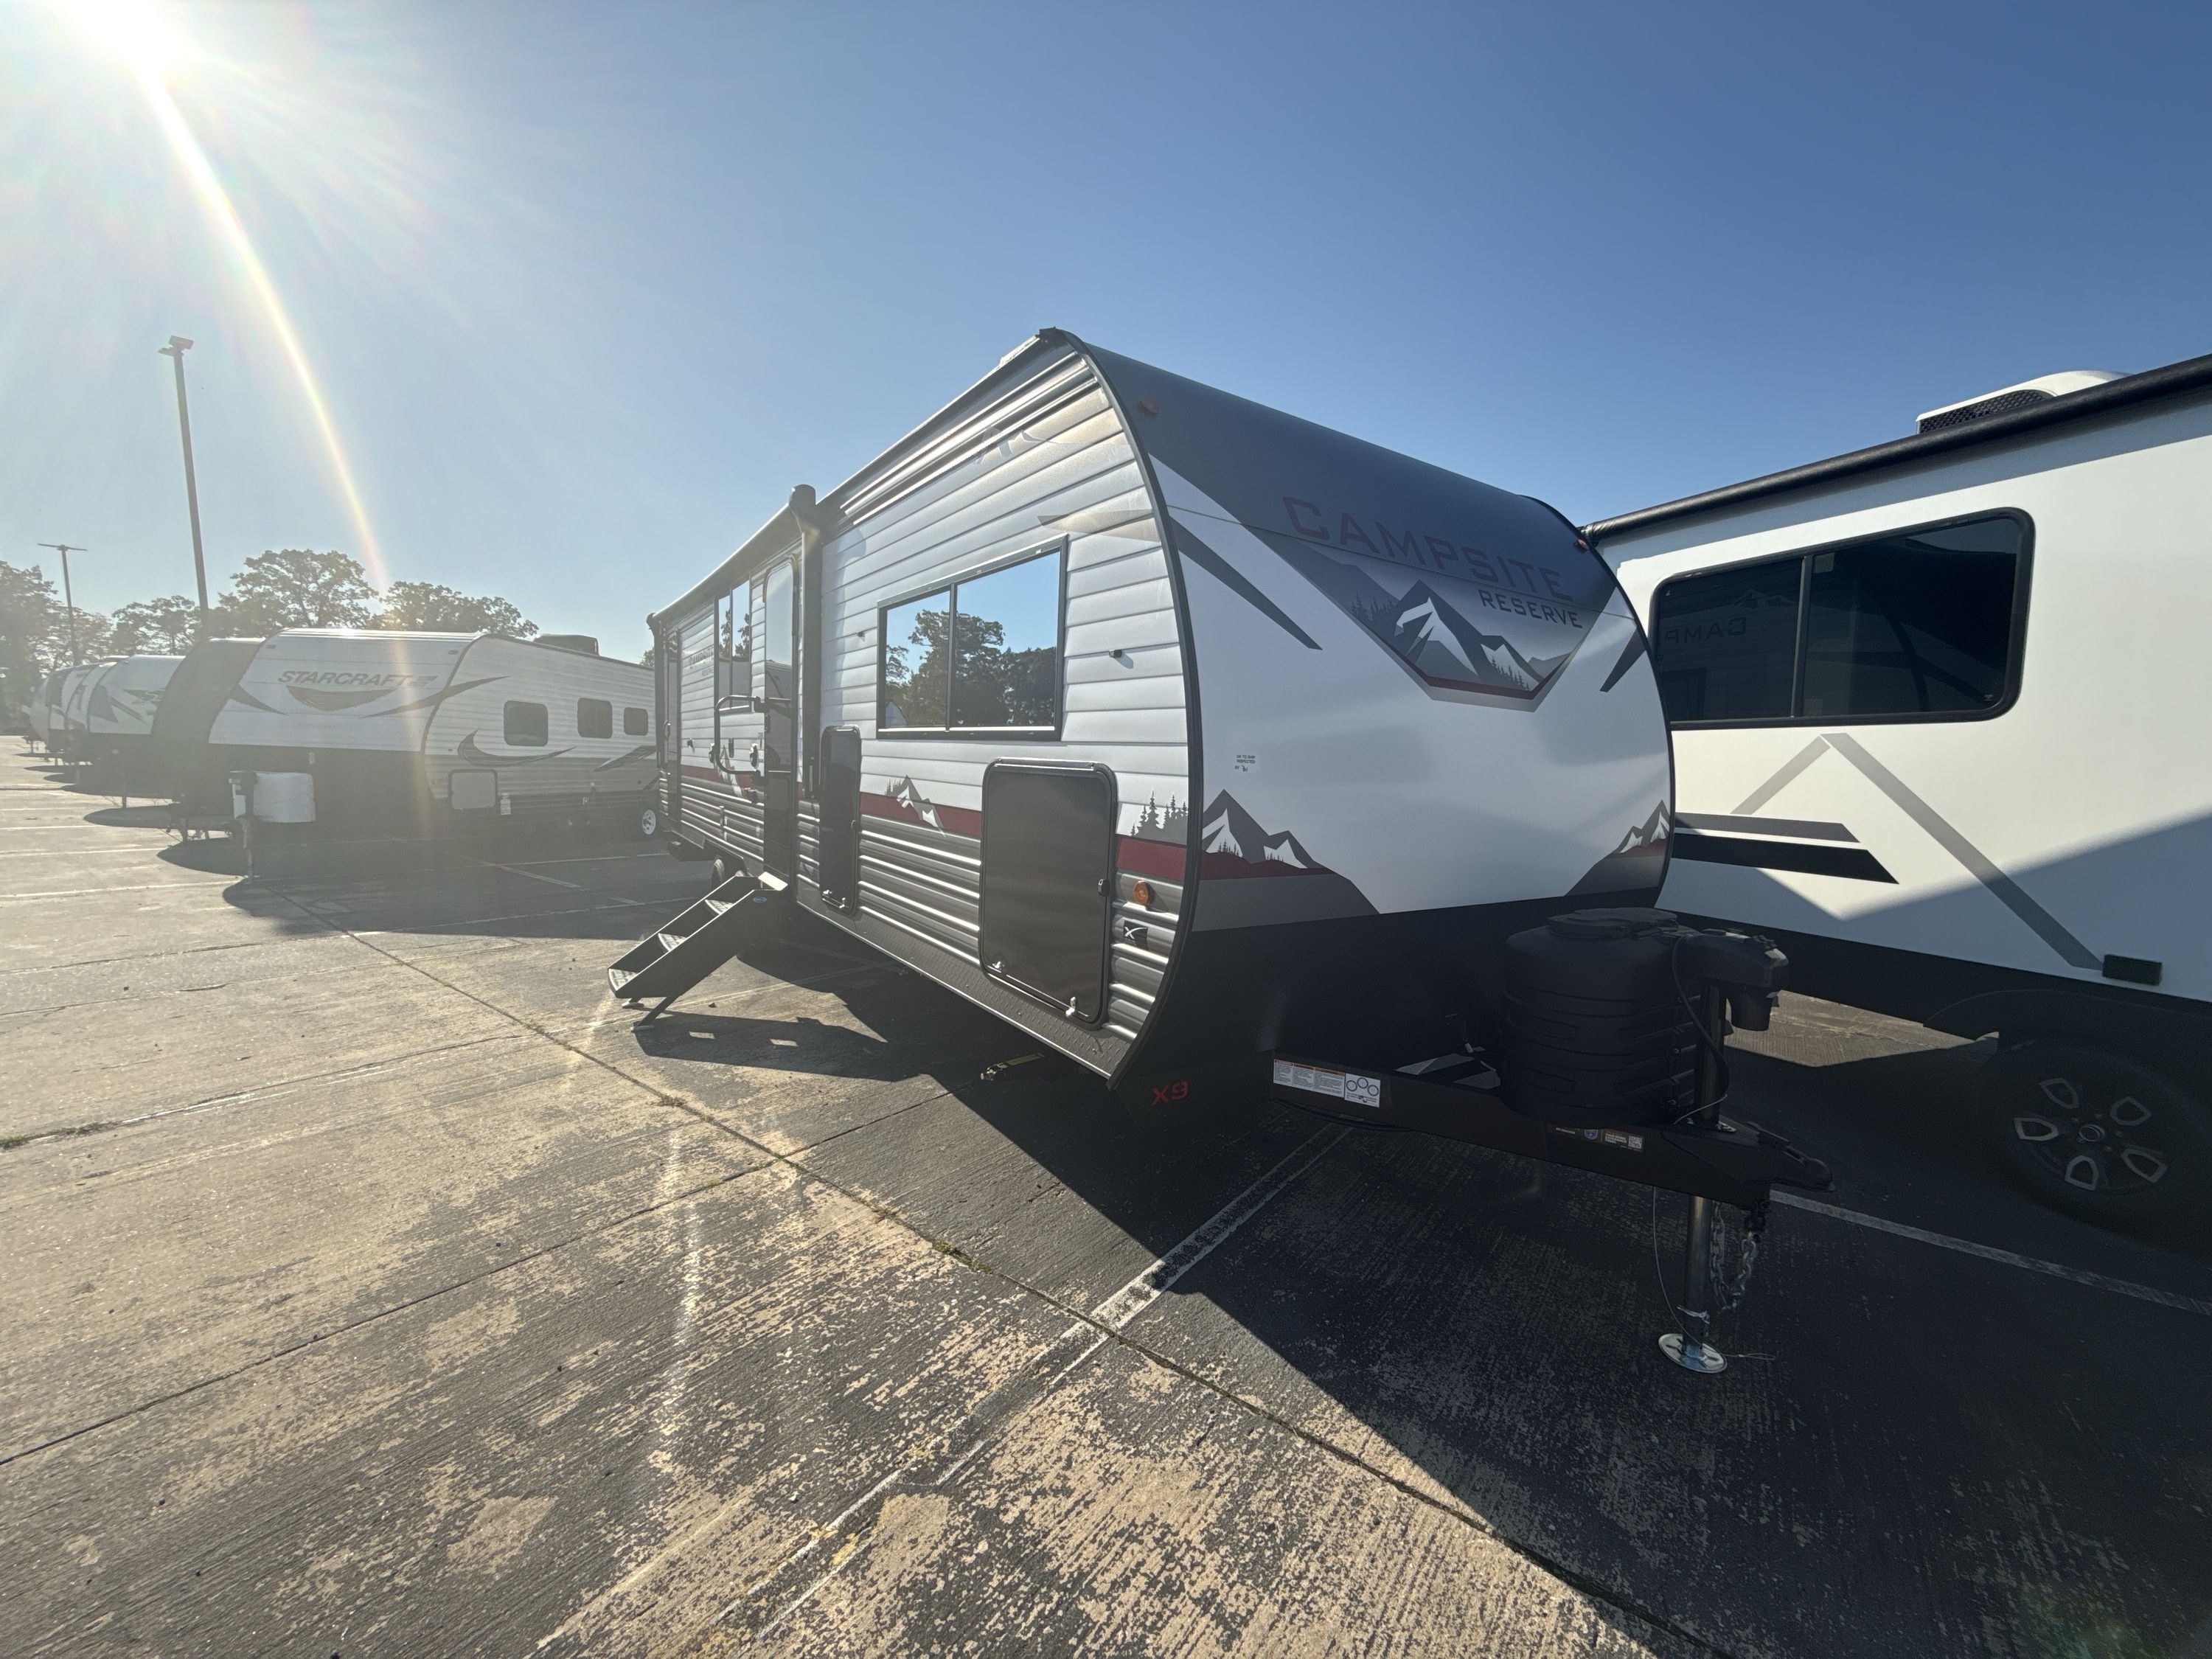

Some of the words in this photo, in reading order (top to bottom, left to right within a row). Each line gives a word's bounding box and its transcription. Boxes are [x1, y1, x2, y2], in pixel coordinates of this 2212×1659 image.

[1283, 495, 1573, 602] CAMPSITE
[1477, 588, 1583, 630] RESERVE
[278, 670, 413, 686] STARCRAFT
